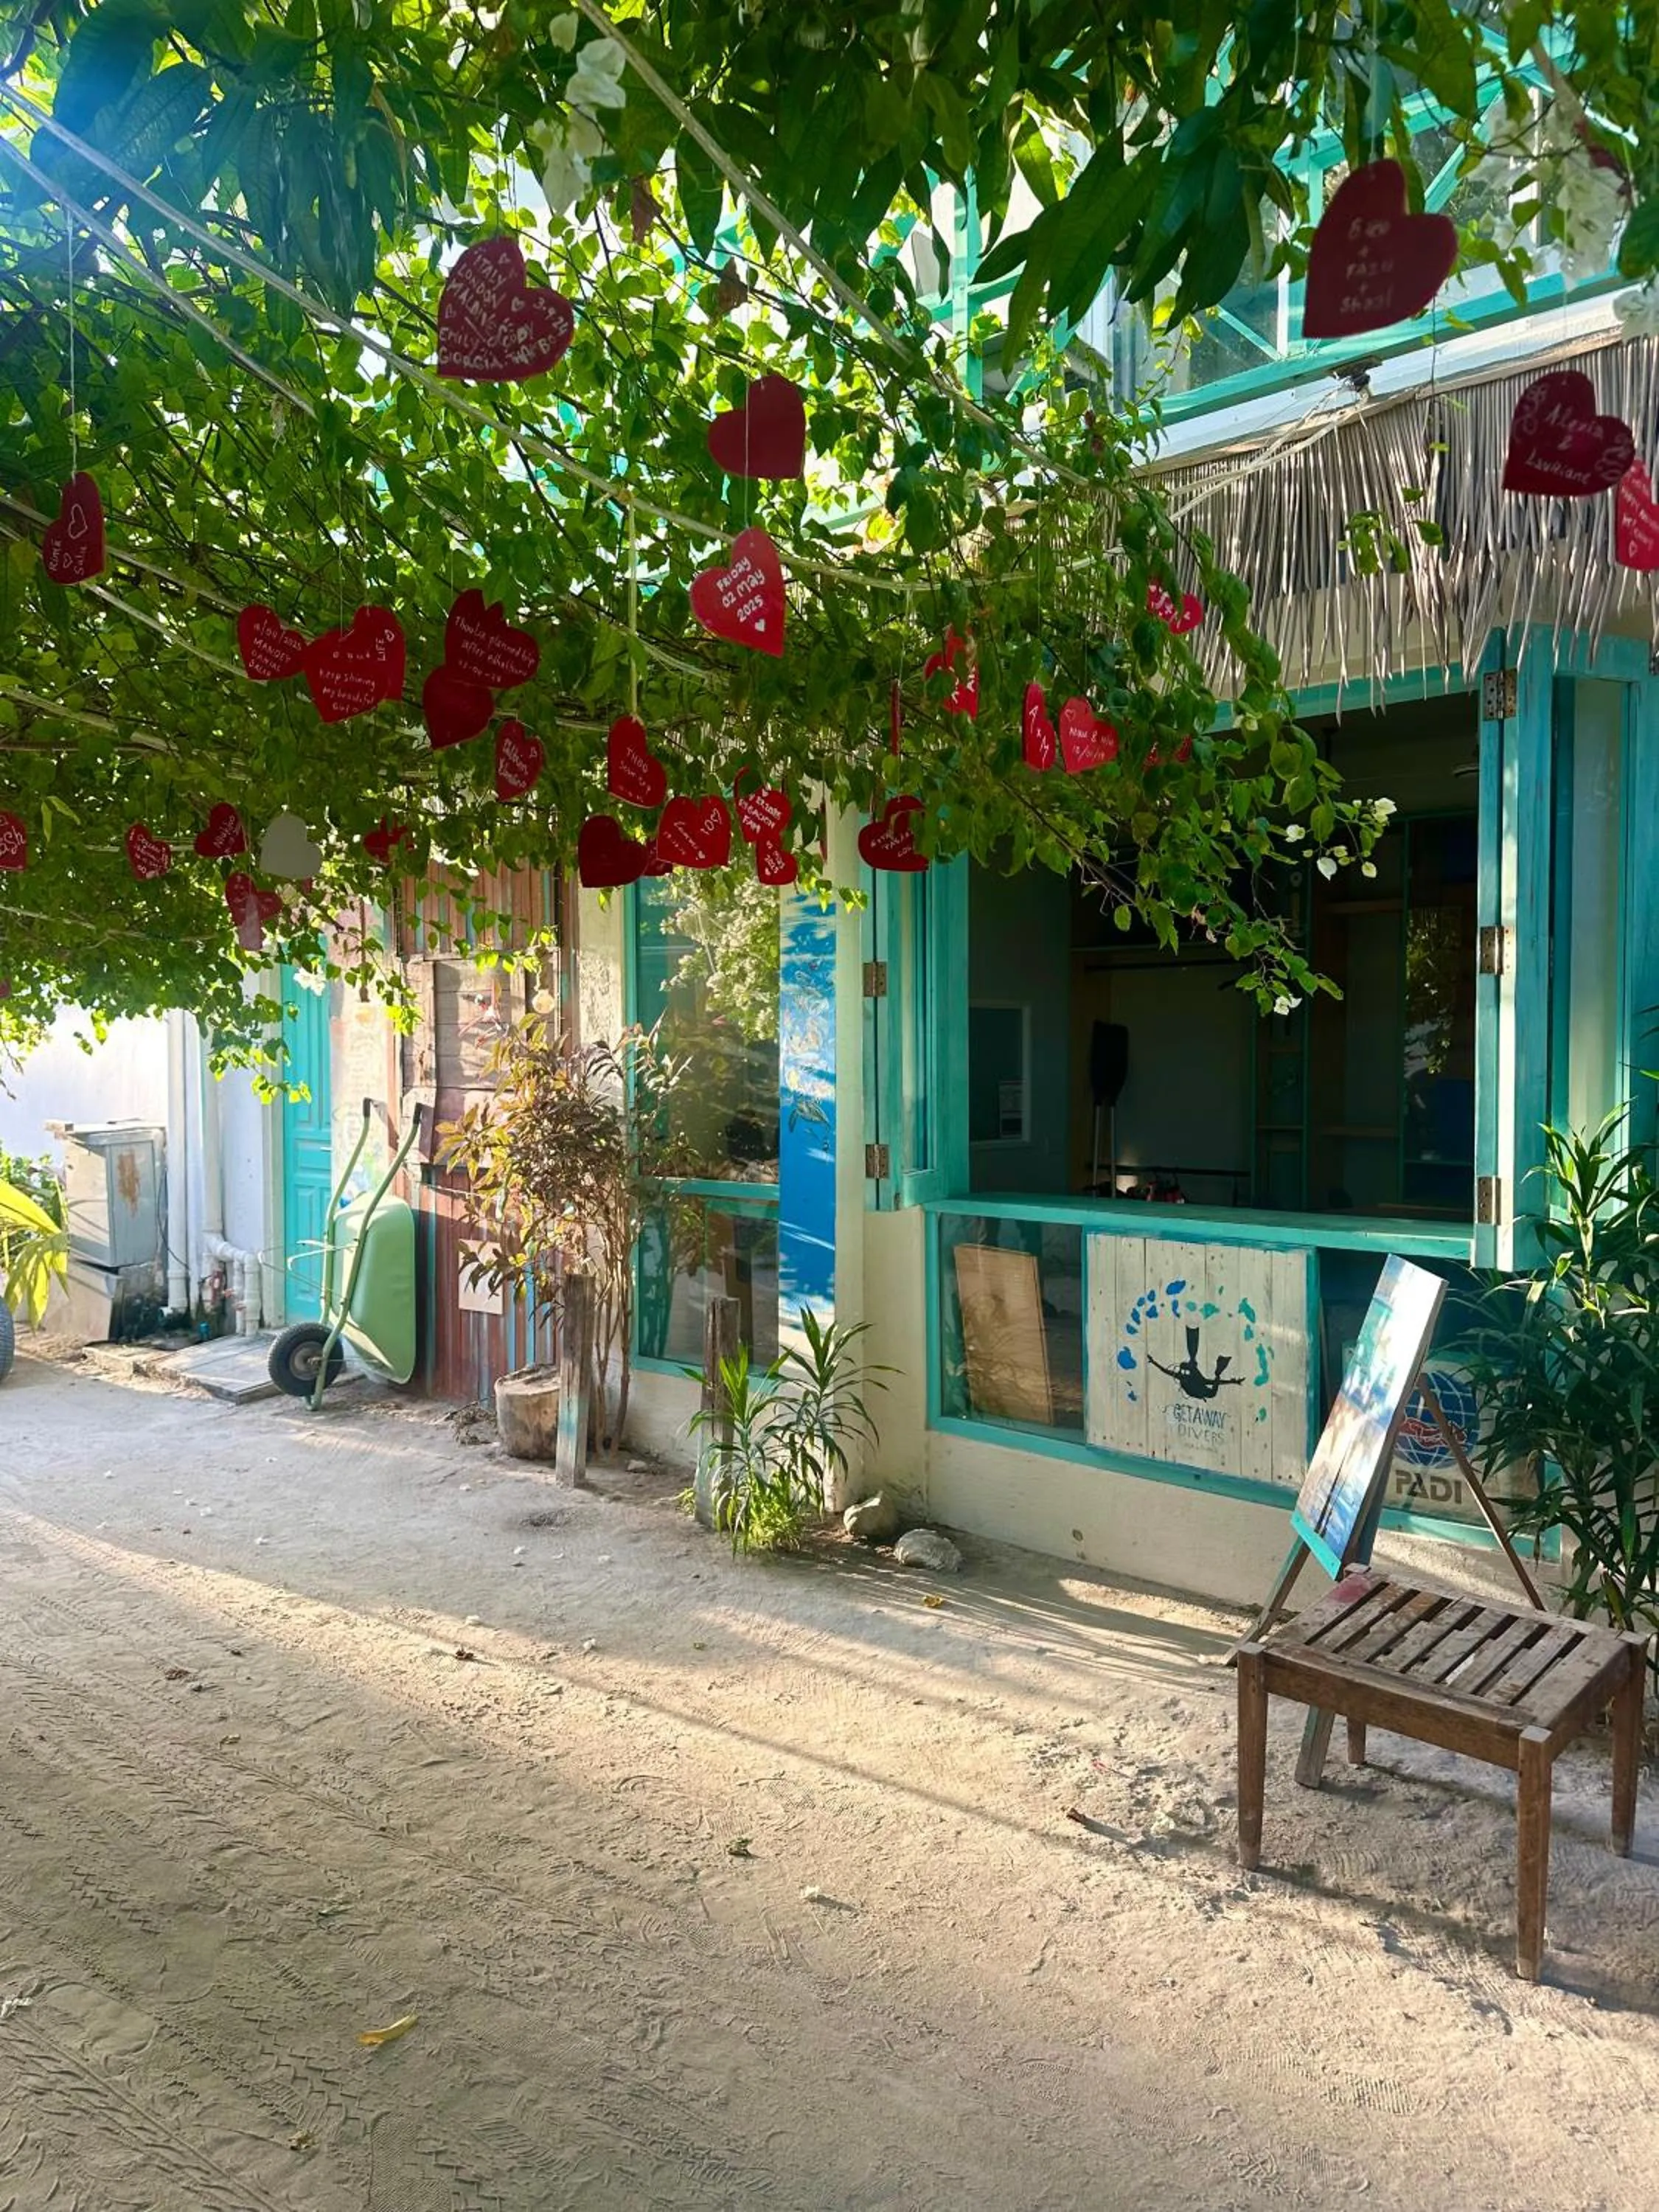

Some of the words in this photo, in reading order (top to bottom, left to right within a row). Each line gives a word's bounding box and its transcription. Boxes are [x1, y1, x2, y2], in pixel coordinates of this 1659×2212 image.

[473, 254, 507, 291] ITALY
[723, 591, 737, 608] 02
[737, 594, 764, 623] 2025
[1173, 1402, 1227, 1430] GETAWAY
[1177, 1423, 1225, 1445] DIVERS
[1394, 1469, 1462, 1505] PADI
